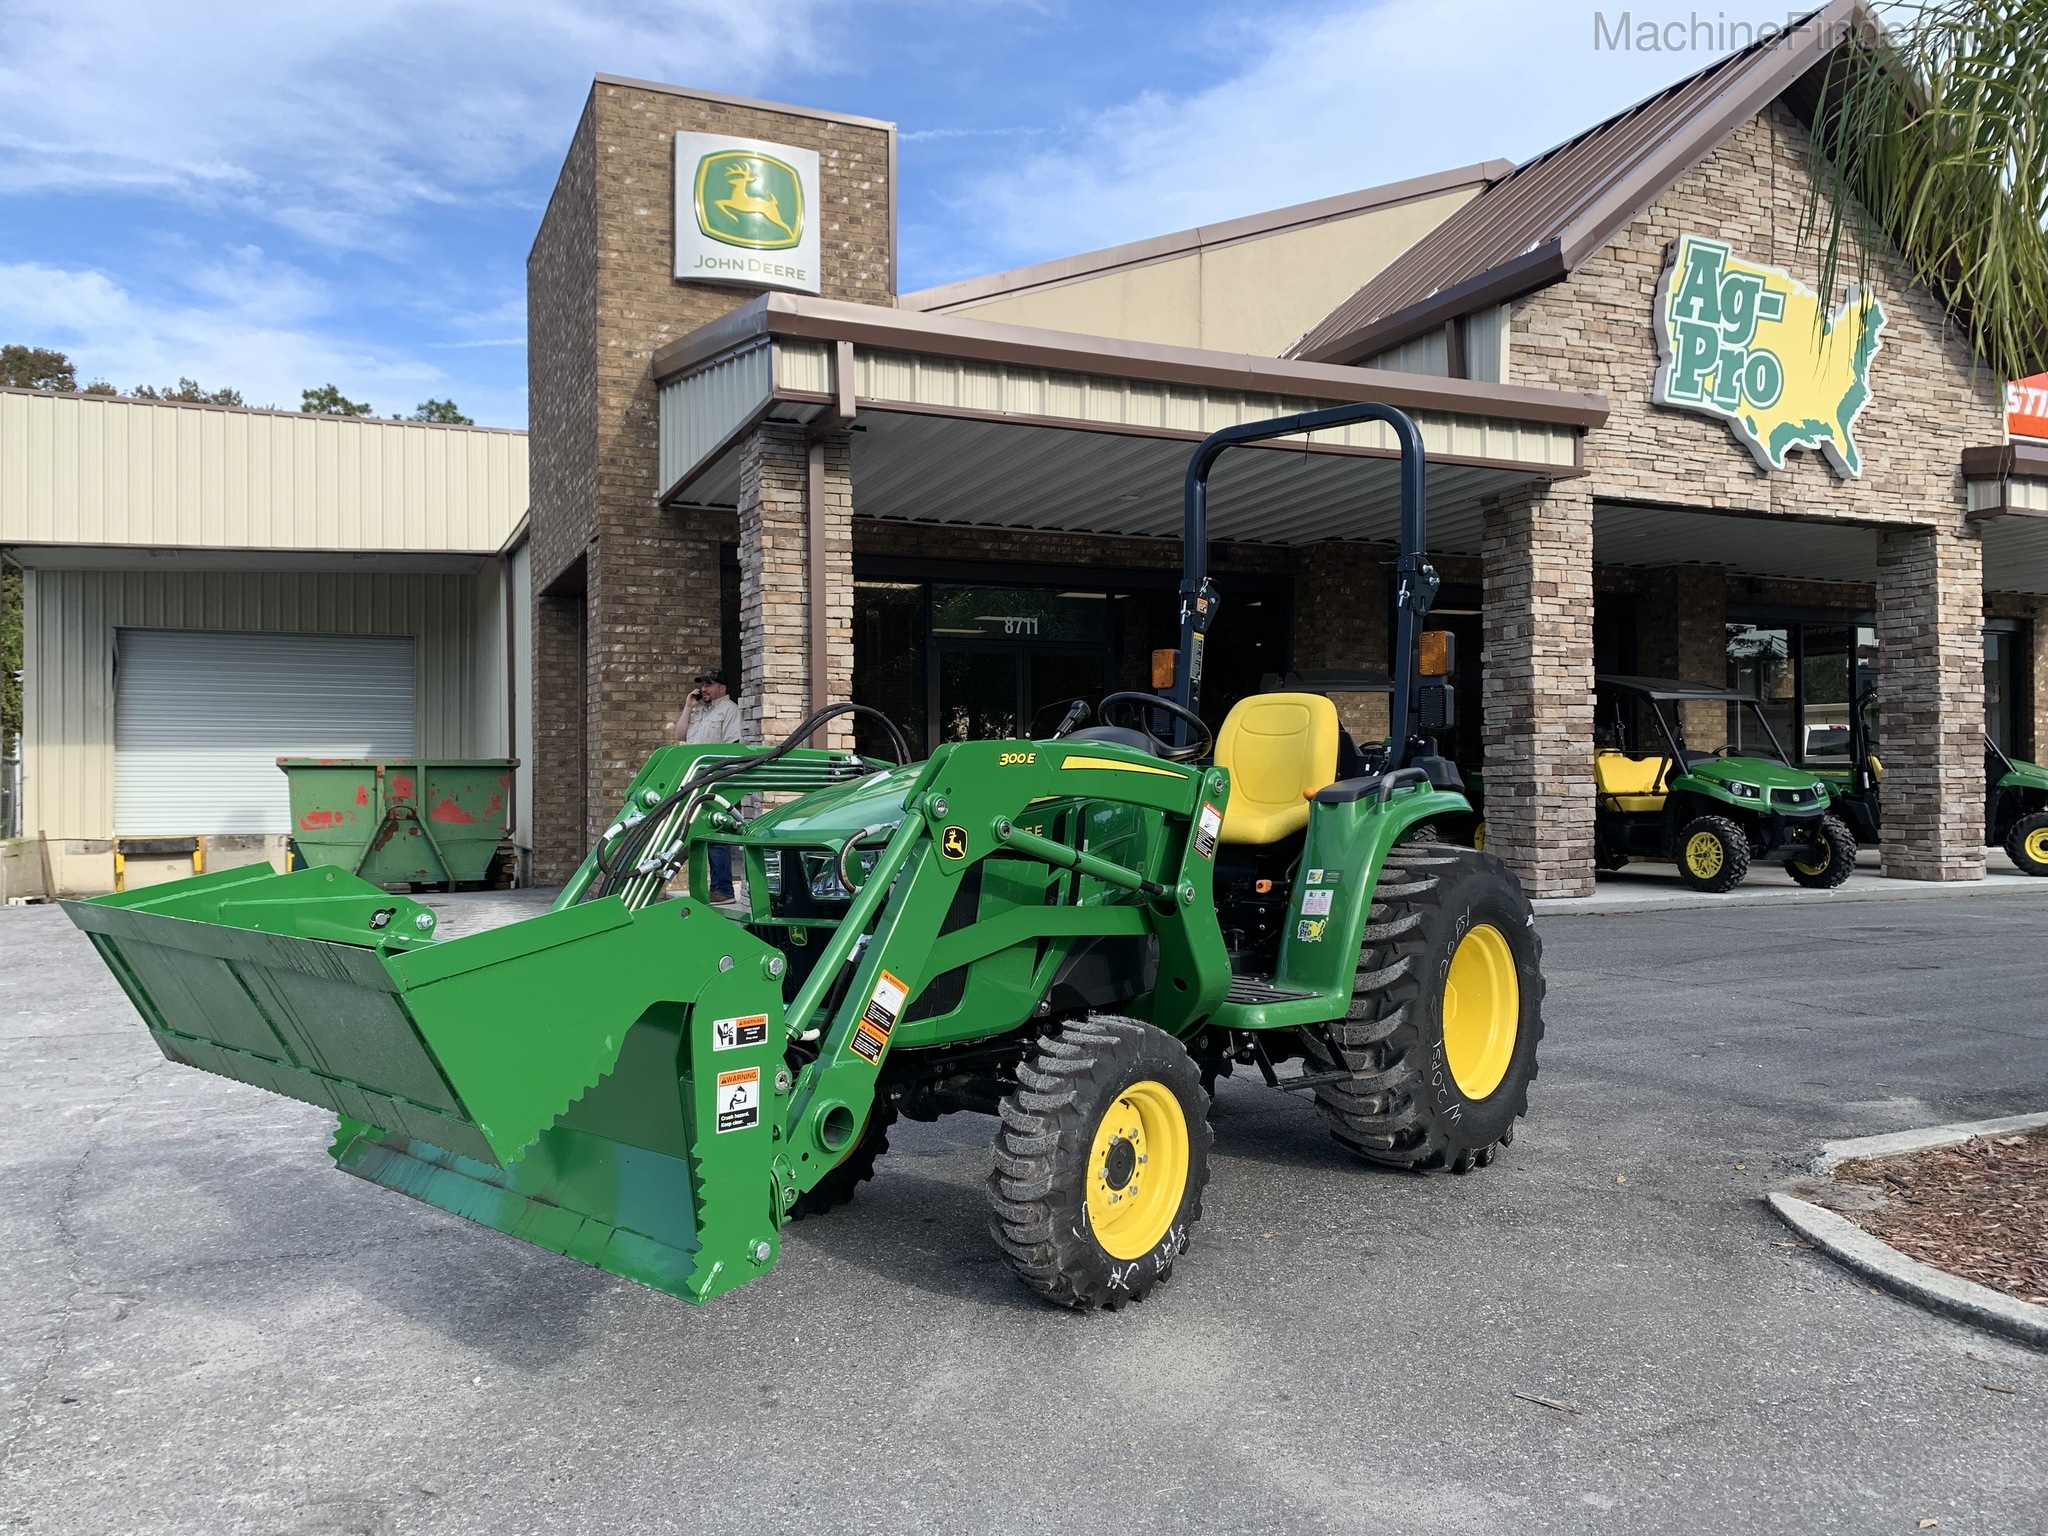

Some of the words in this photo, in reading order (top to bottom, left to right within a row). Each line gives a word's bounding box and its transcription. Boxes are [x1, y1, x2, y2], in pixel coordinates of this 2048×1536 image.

[693, 254, 745, 271] JOHN
[748, 258, 806, 281] DEERE
[1673, 243, 1786, 344] Ag-
[1671, 327, 1781, 406] Pro
[2007, 384, 2048, 419] STI
[1004, 616, 1038, 635] 8711
[726, 1071, 757, 1083] WARNING
